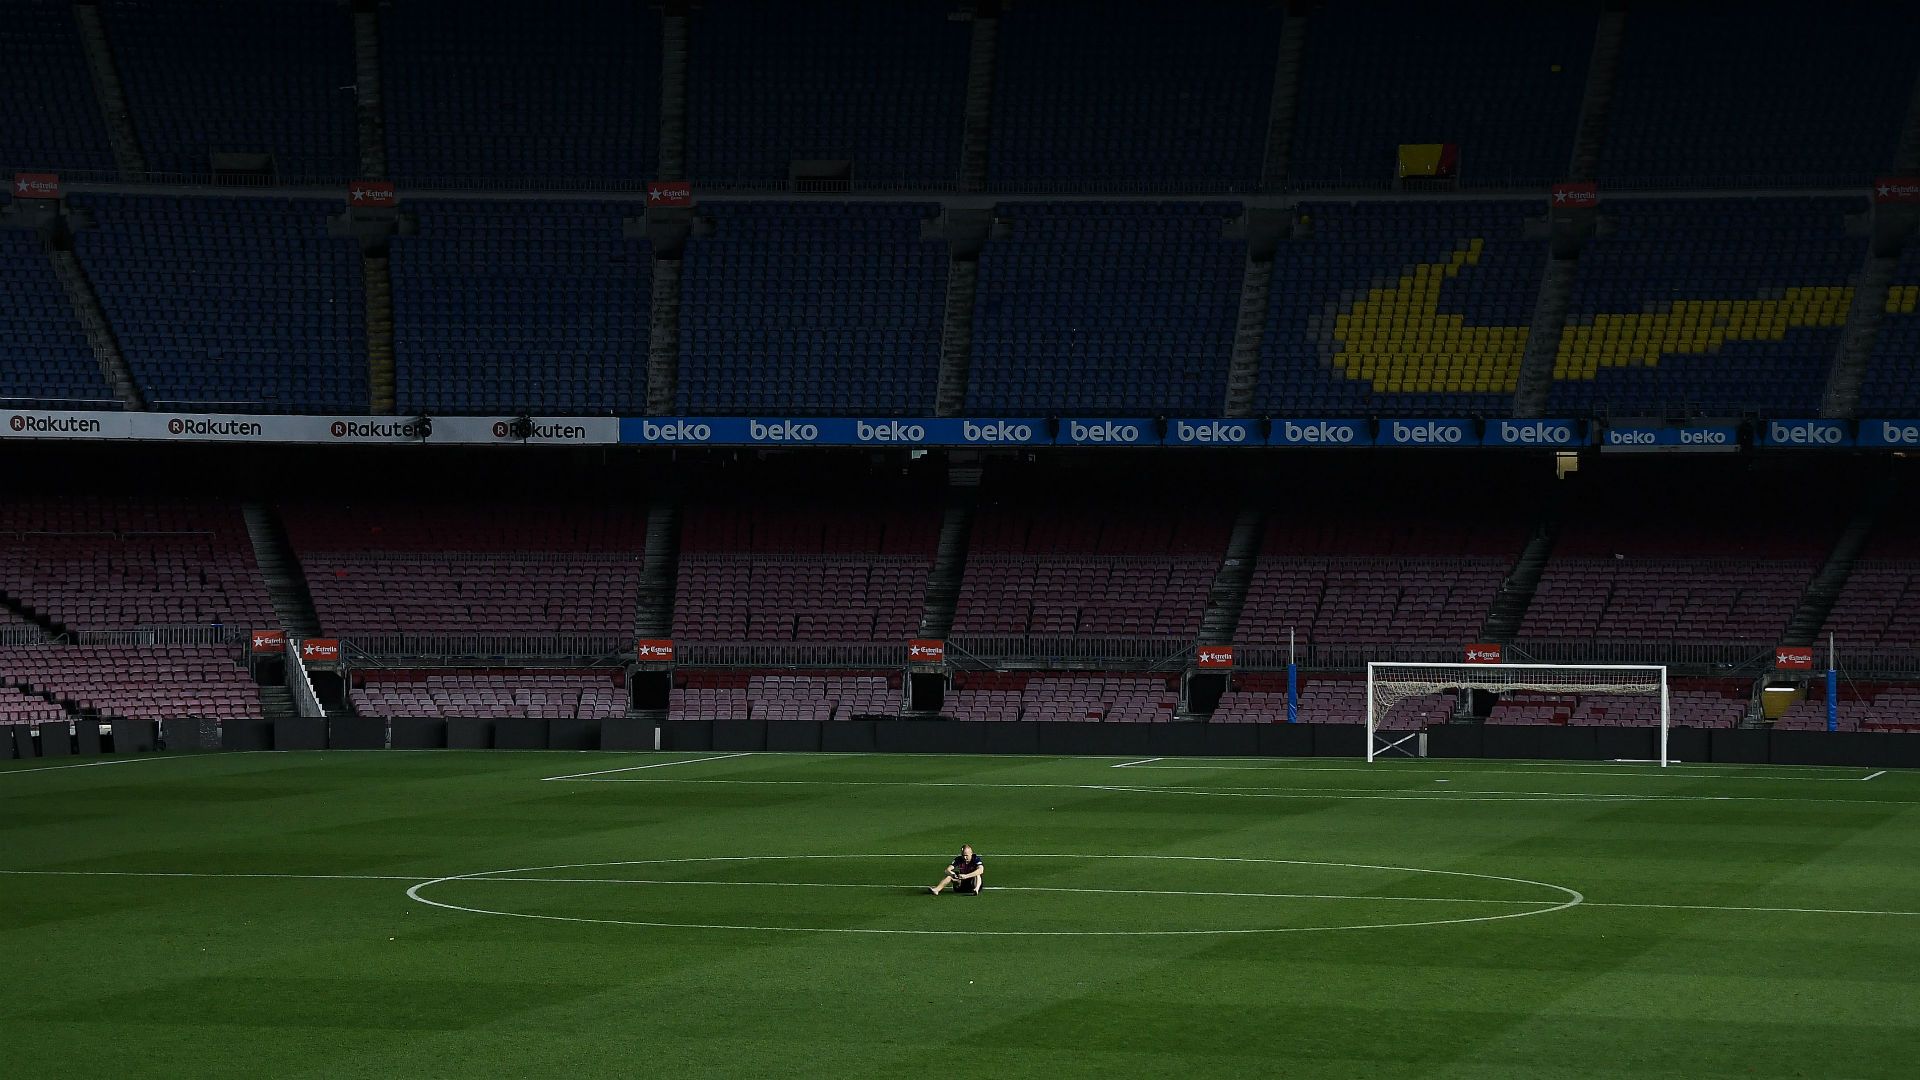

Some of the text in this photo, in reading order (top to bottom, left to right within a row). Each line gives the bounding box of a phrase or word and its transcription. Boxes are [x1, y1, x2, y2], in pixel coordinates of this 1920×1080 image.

[663, 189, 690, 197] Estrella
[1568, 191, 1596, 199] Estrella
[26, 415, 100, 432] Rakuten
[185, 418, 262, 436] Rakuten
[510, 422, 586, 439] Rkuten
[644, 421, 710, 441] beko
[751, 421, 817, 441] beko
[857, 421, 924, 441] beko
[964, 421, 1031, 442] beko
[1071, 421, 1138, 443] beko
[1178, 422, 1245, 443] beko
[1286, 422, 1353, 443] beko
[1394, 422, 1461, 443] beko
[1502, 422, 1570, 444] beko
[1771, 421, 1842, 444] beko
[1883, 421, 1920, 443] be
[1611, 430, 1656, 444] beko
[1680, 430, 1726, 444] beko
